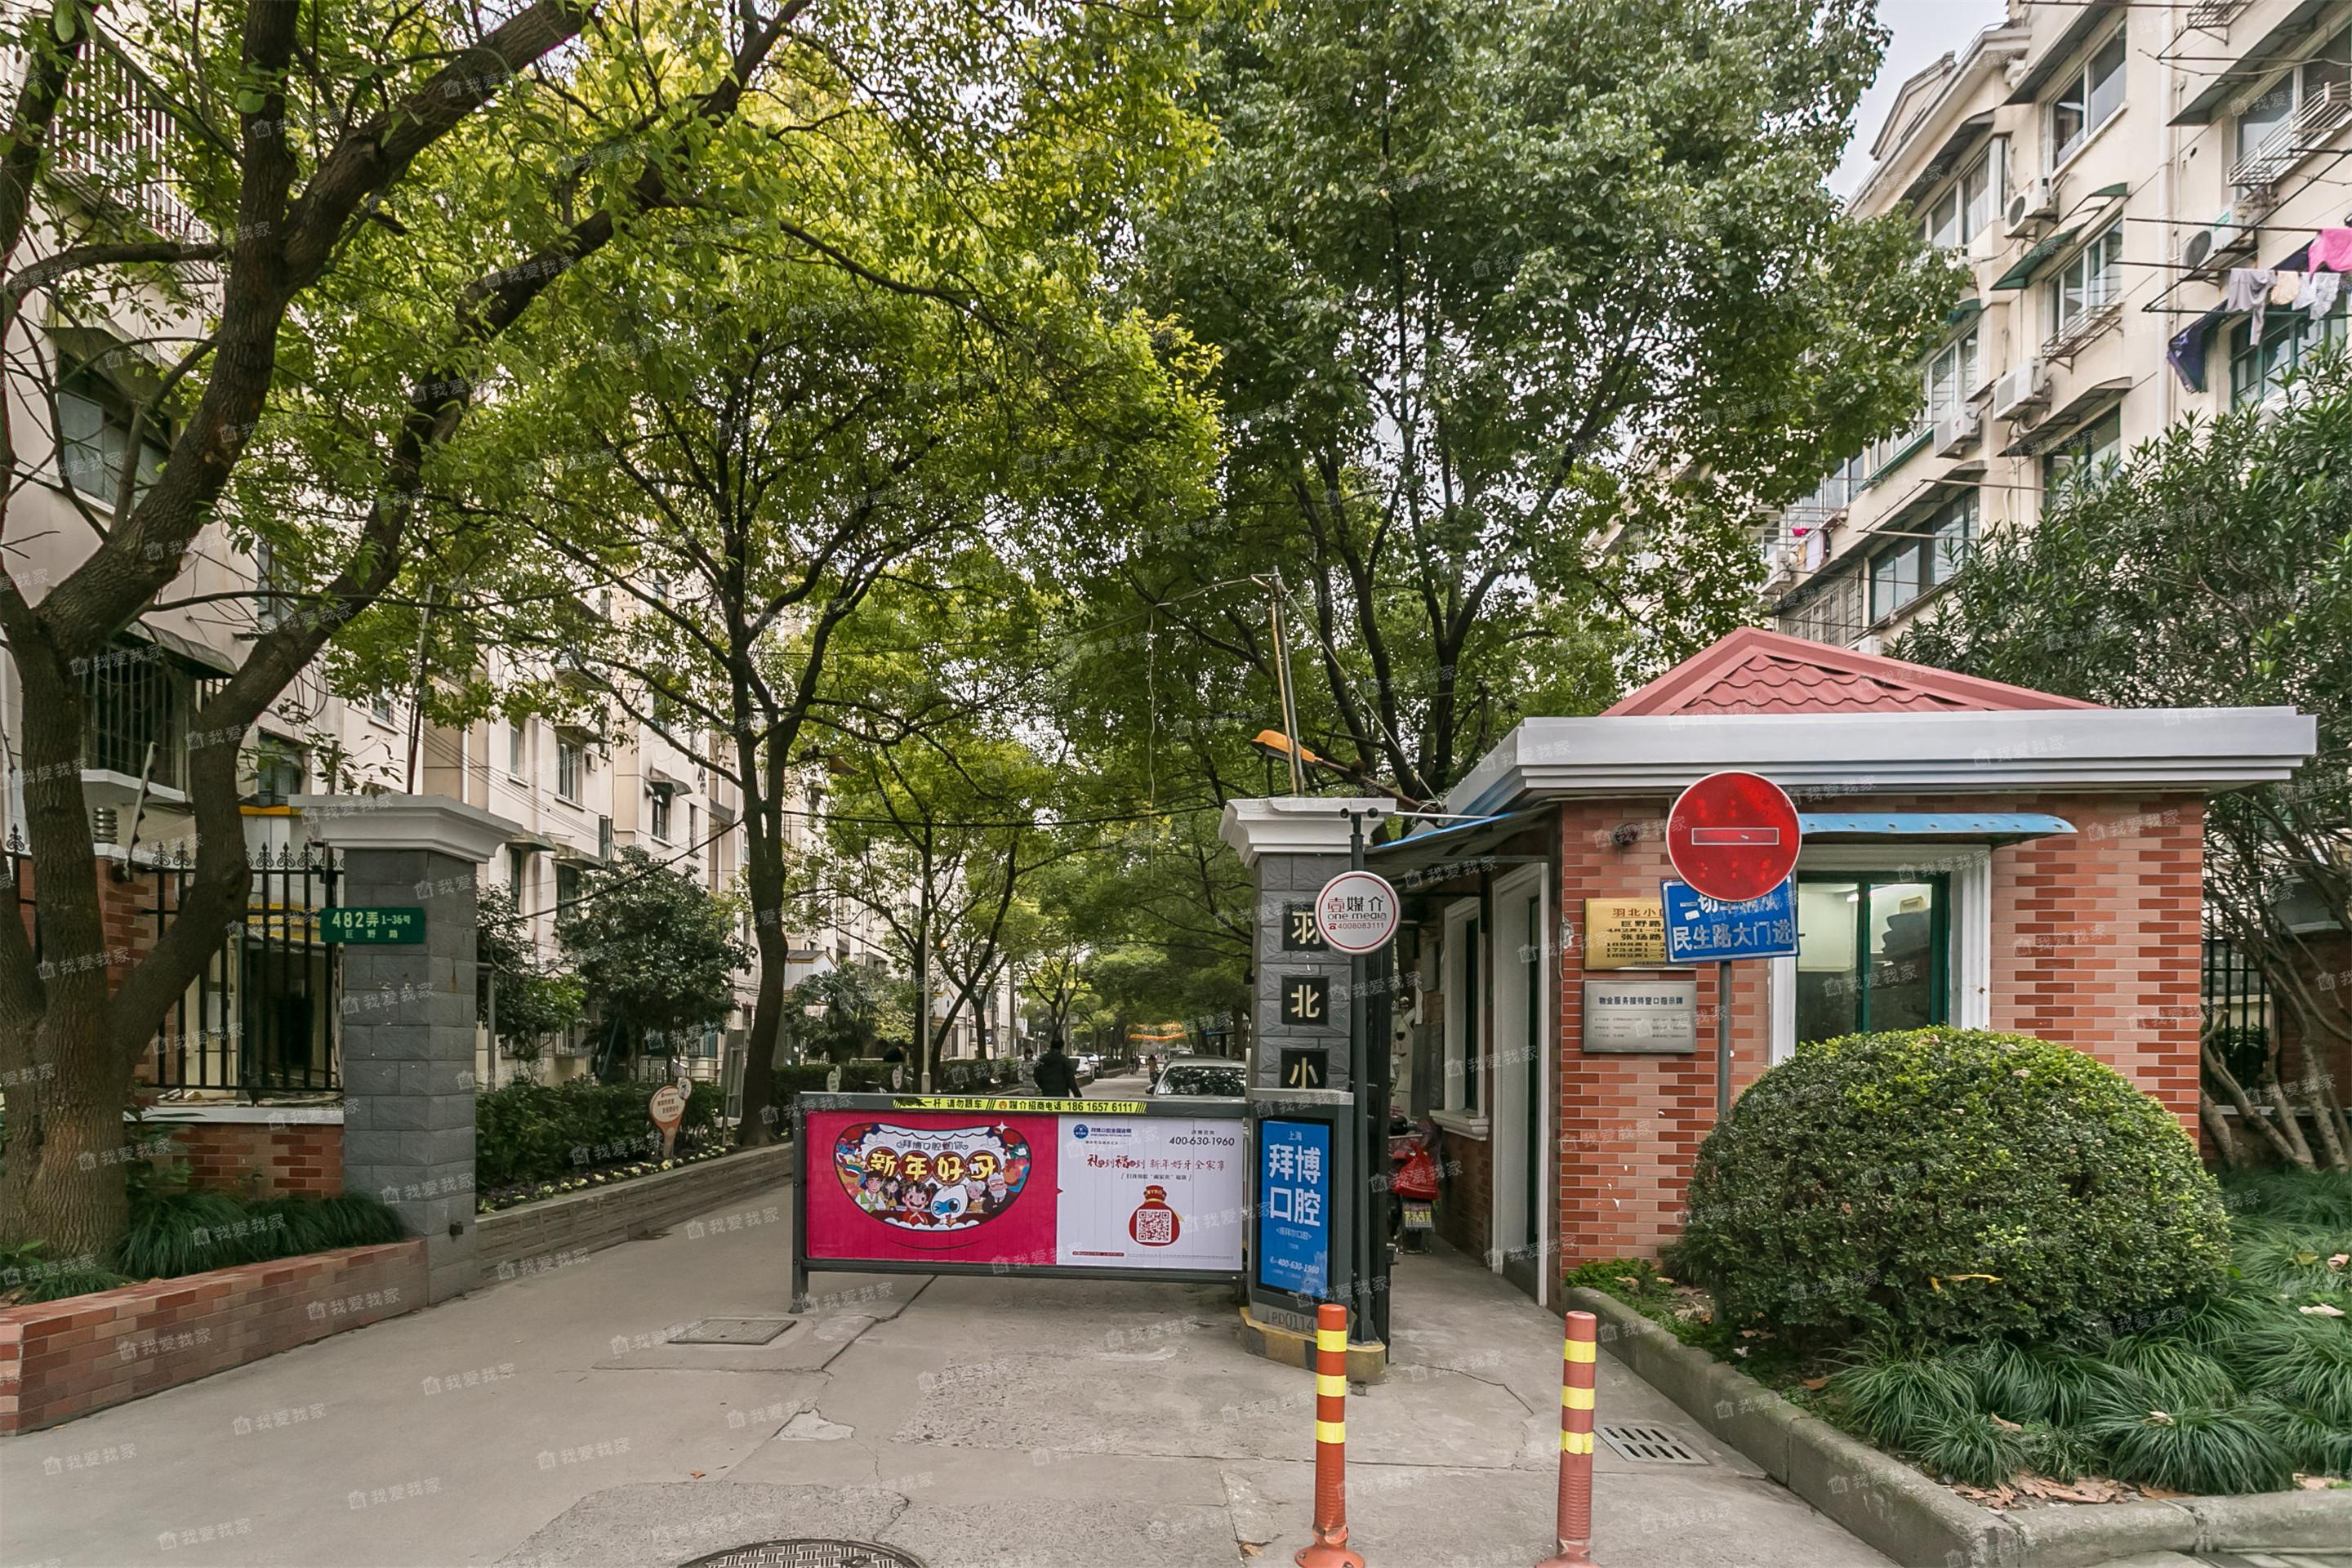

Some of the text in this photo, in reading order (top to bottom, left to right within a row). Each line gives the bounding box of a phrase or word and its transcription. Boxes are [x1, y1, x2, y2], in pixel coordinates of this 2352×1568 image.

[1328, 896, 1383, 912] 壹媒介
[1613, 908, 1663, 917] 羽北小
[345, 929, 398, 938] 巨野路
[1672, 919, 1793, 951] 民生路大门进
[1067, 1102, 1084, 1111] 186
[1088, 1102, 1108, 1111] 1657
[1111, 1102, 1133, 1112] 6111
[1169, 1137, 1235, 1146] 400-630-1960
[870, 1151, 996, 1181] 新年好牙
[1269, 1143, 1321, 1185] 拜博
[1269, 1186, 1321, 1227] 口腔
[1271, 1312, 1315, 1334] PD0114
